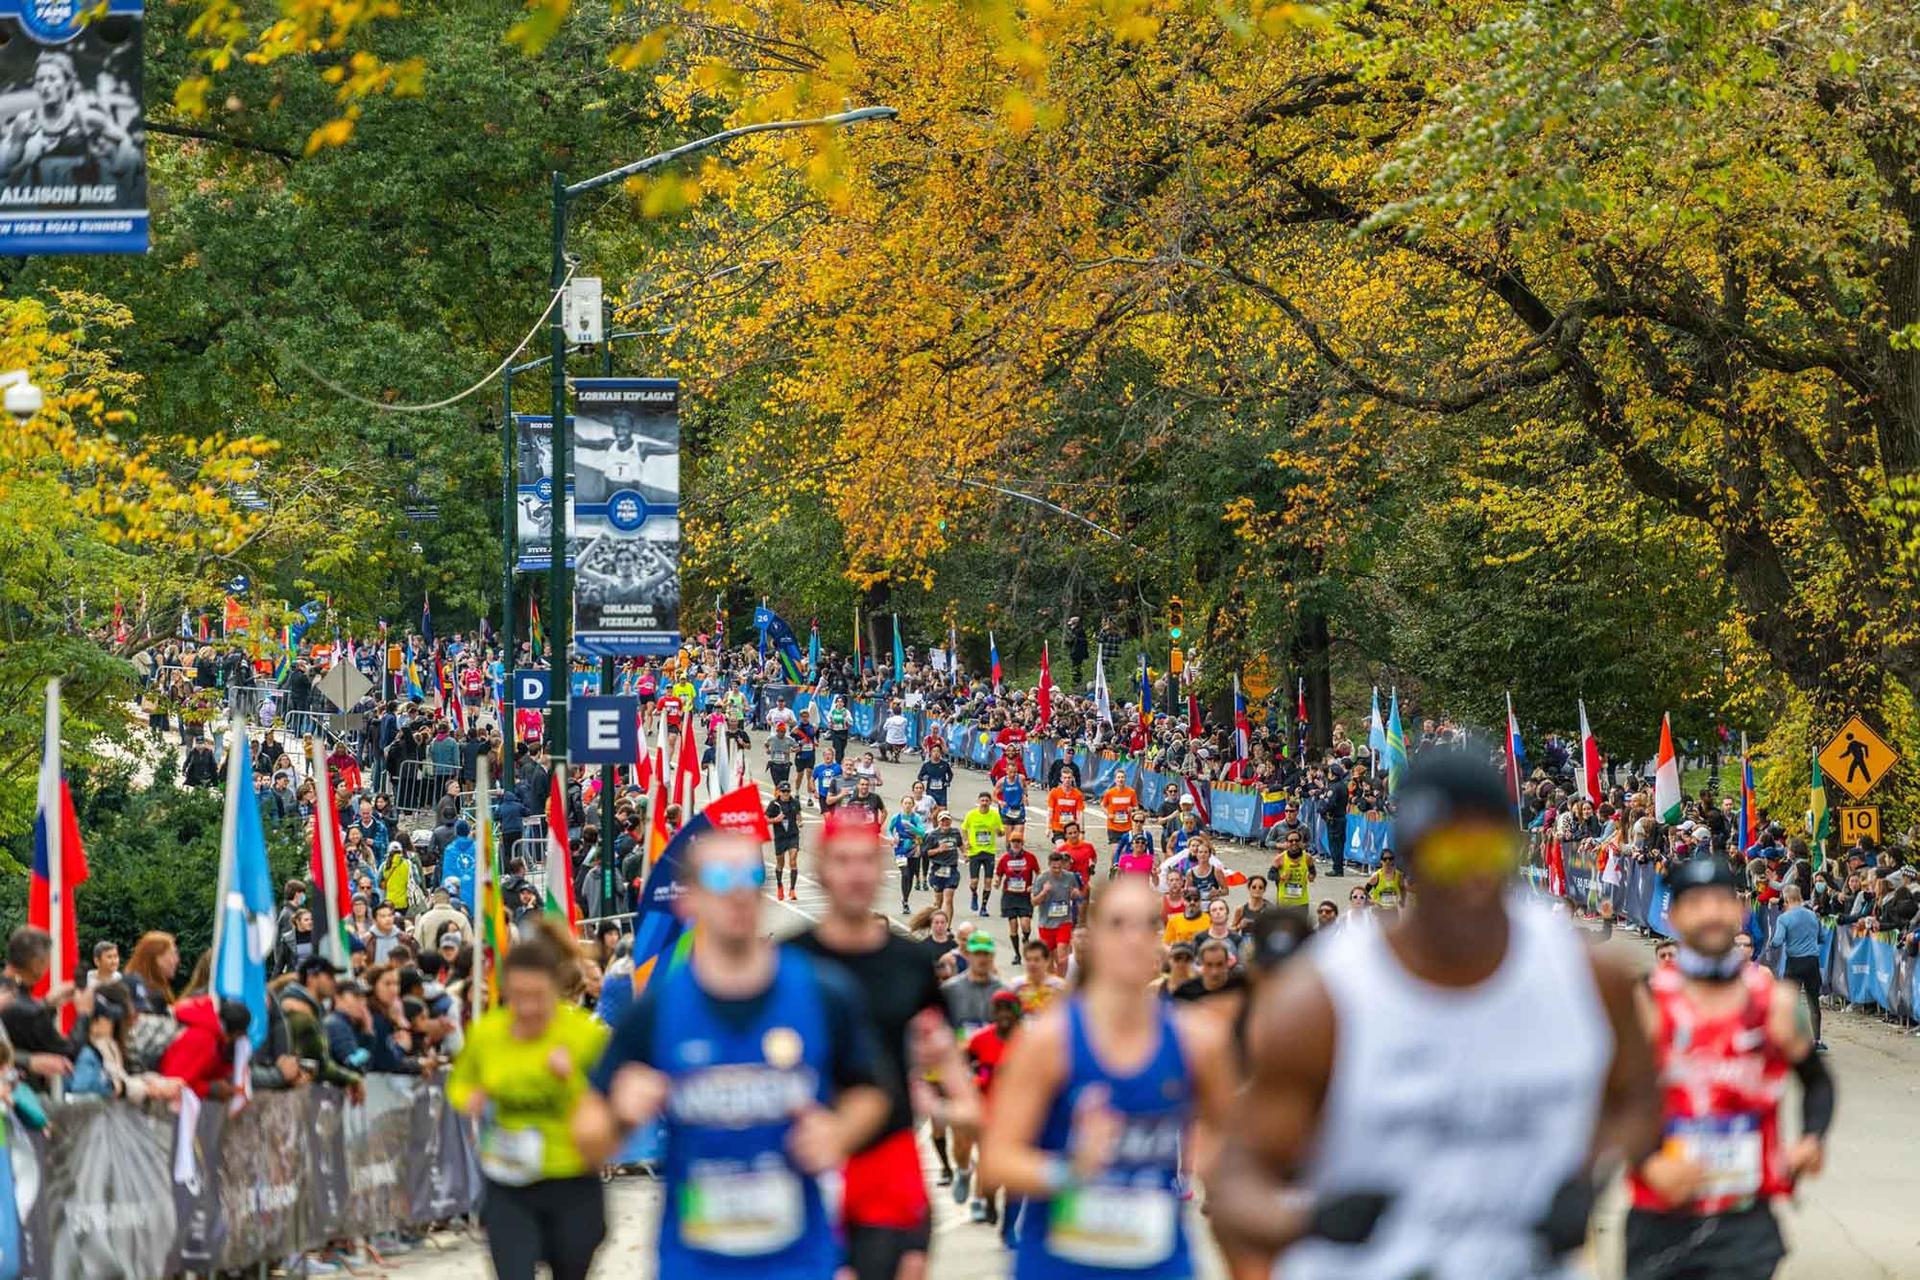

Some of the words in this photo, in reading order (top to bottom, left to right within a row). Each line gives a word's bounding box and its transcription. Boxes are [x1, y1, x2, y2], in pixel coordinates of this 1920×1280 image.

[0, 185, 78, 205] ALLISON
[79, 184, 117, 204] ROE
[579, 391, 621, 401] LORNAH
[623, 391, 675, 401] KIPLAGAT
[603, 604, 653, 614] ORLANDO
[757, 614, 769, 623] 26
[523, 678, 544, 700] D
[588, 709, 620, 749] E
[1847, 811, 1872, 830] 10
